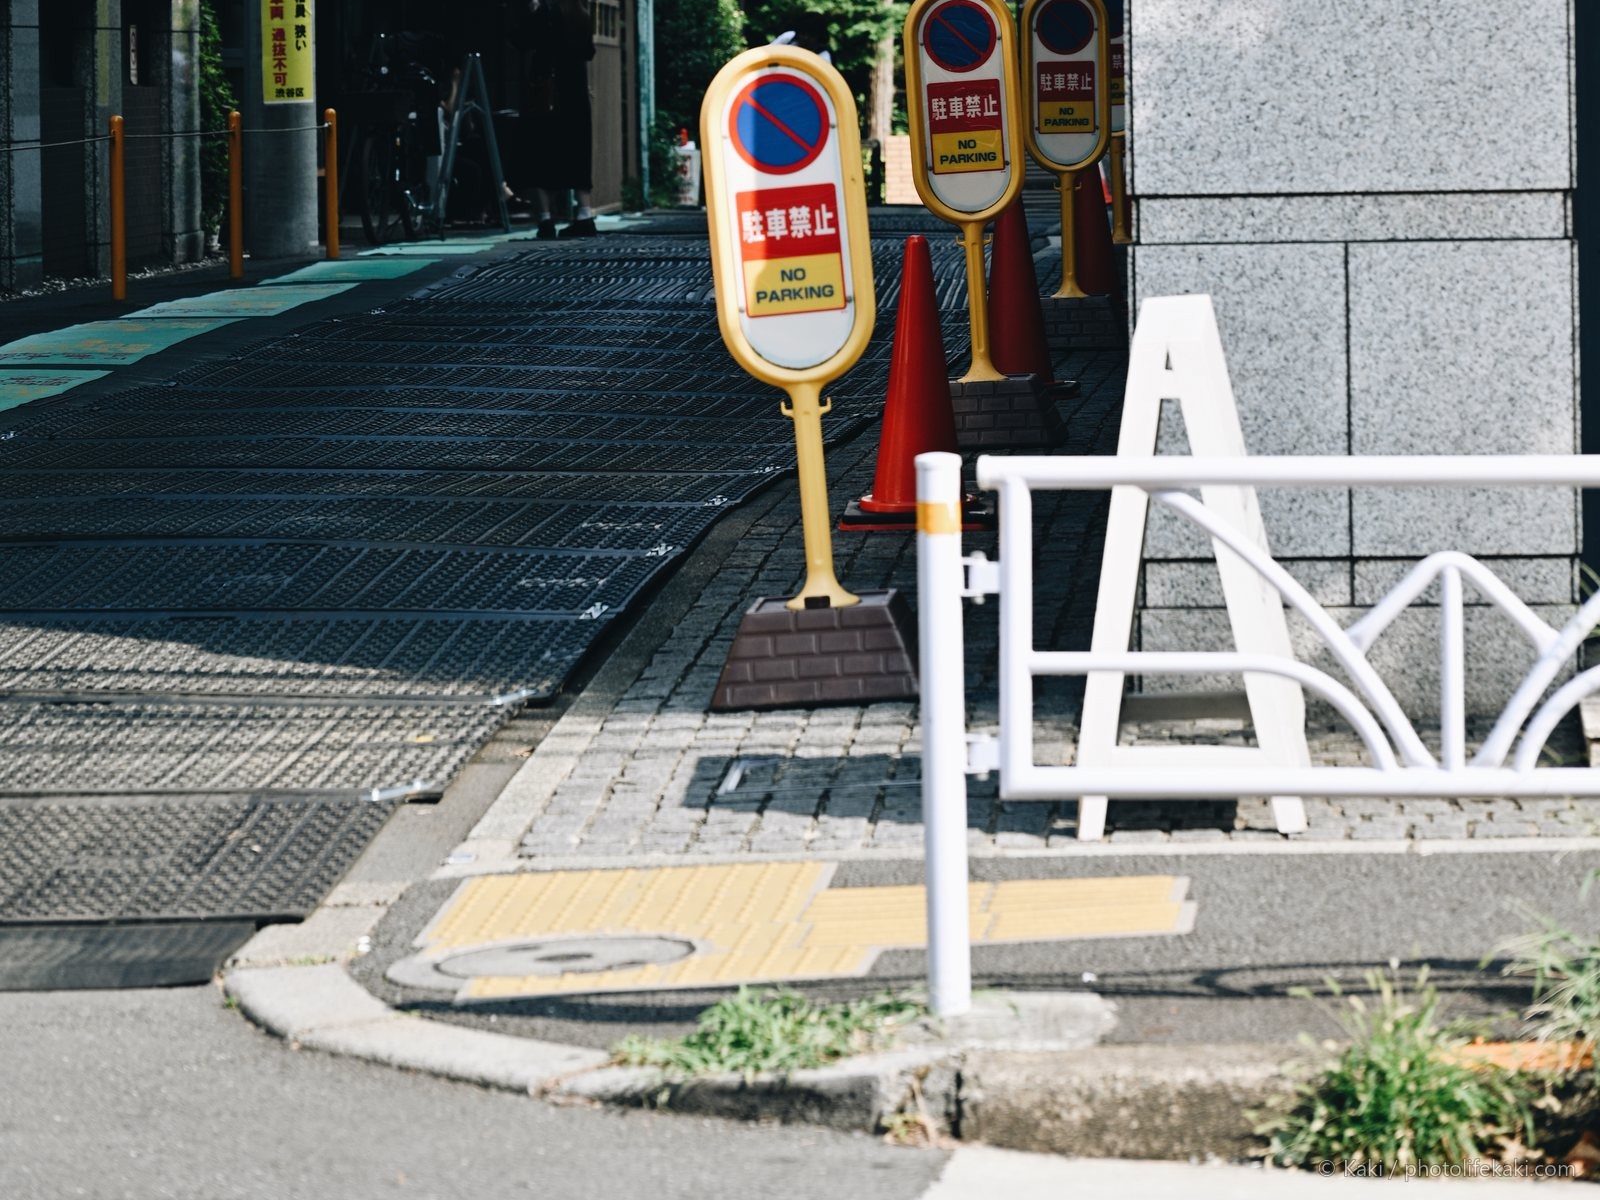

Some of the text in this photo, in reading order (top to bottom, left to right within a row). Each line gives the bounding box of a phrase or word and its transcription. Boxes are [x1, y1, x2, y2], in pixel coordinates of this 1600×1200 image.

[1040, 73, 1093, 92] 駐車禁止
[275, 87, 305, 98] 渋谷区
[931, 93, 999, 121] 駐車禁止
[1059, 107, 1074, 116] NO
[1044, 117, 1089, 127] PARKING
[957, 139, 977, 150] NO
[939, 151, 997, 166] PARKING
[741, 202, 836, 244] 駐車禁止
[780, 267, 807, 283] NO
[756, 283, 835, 305] PARKING
